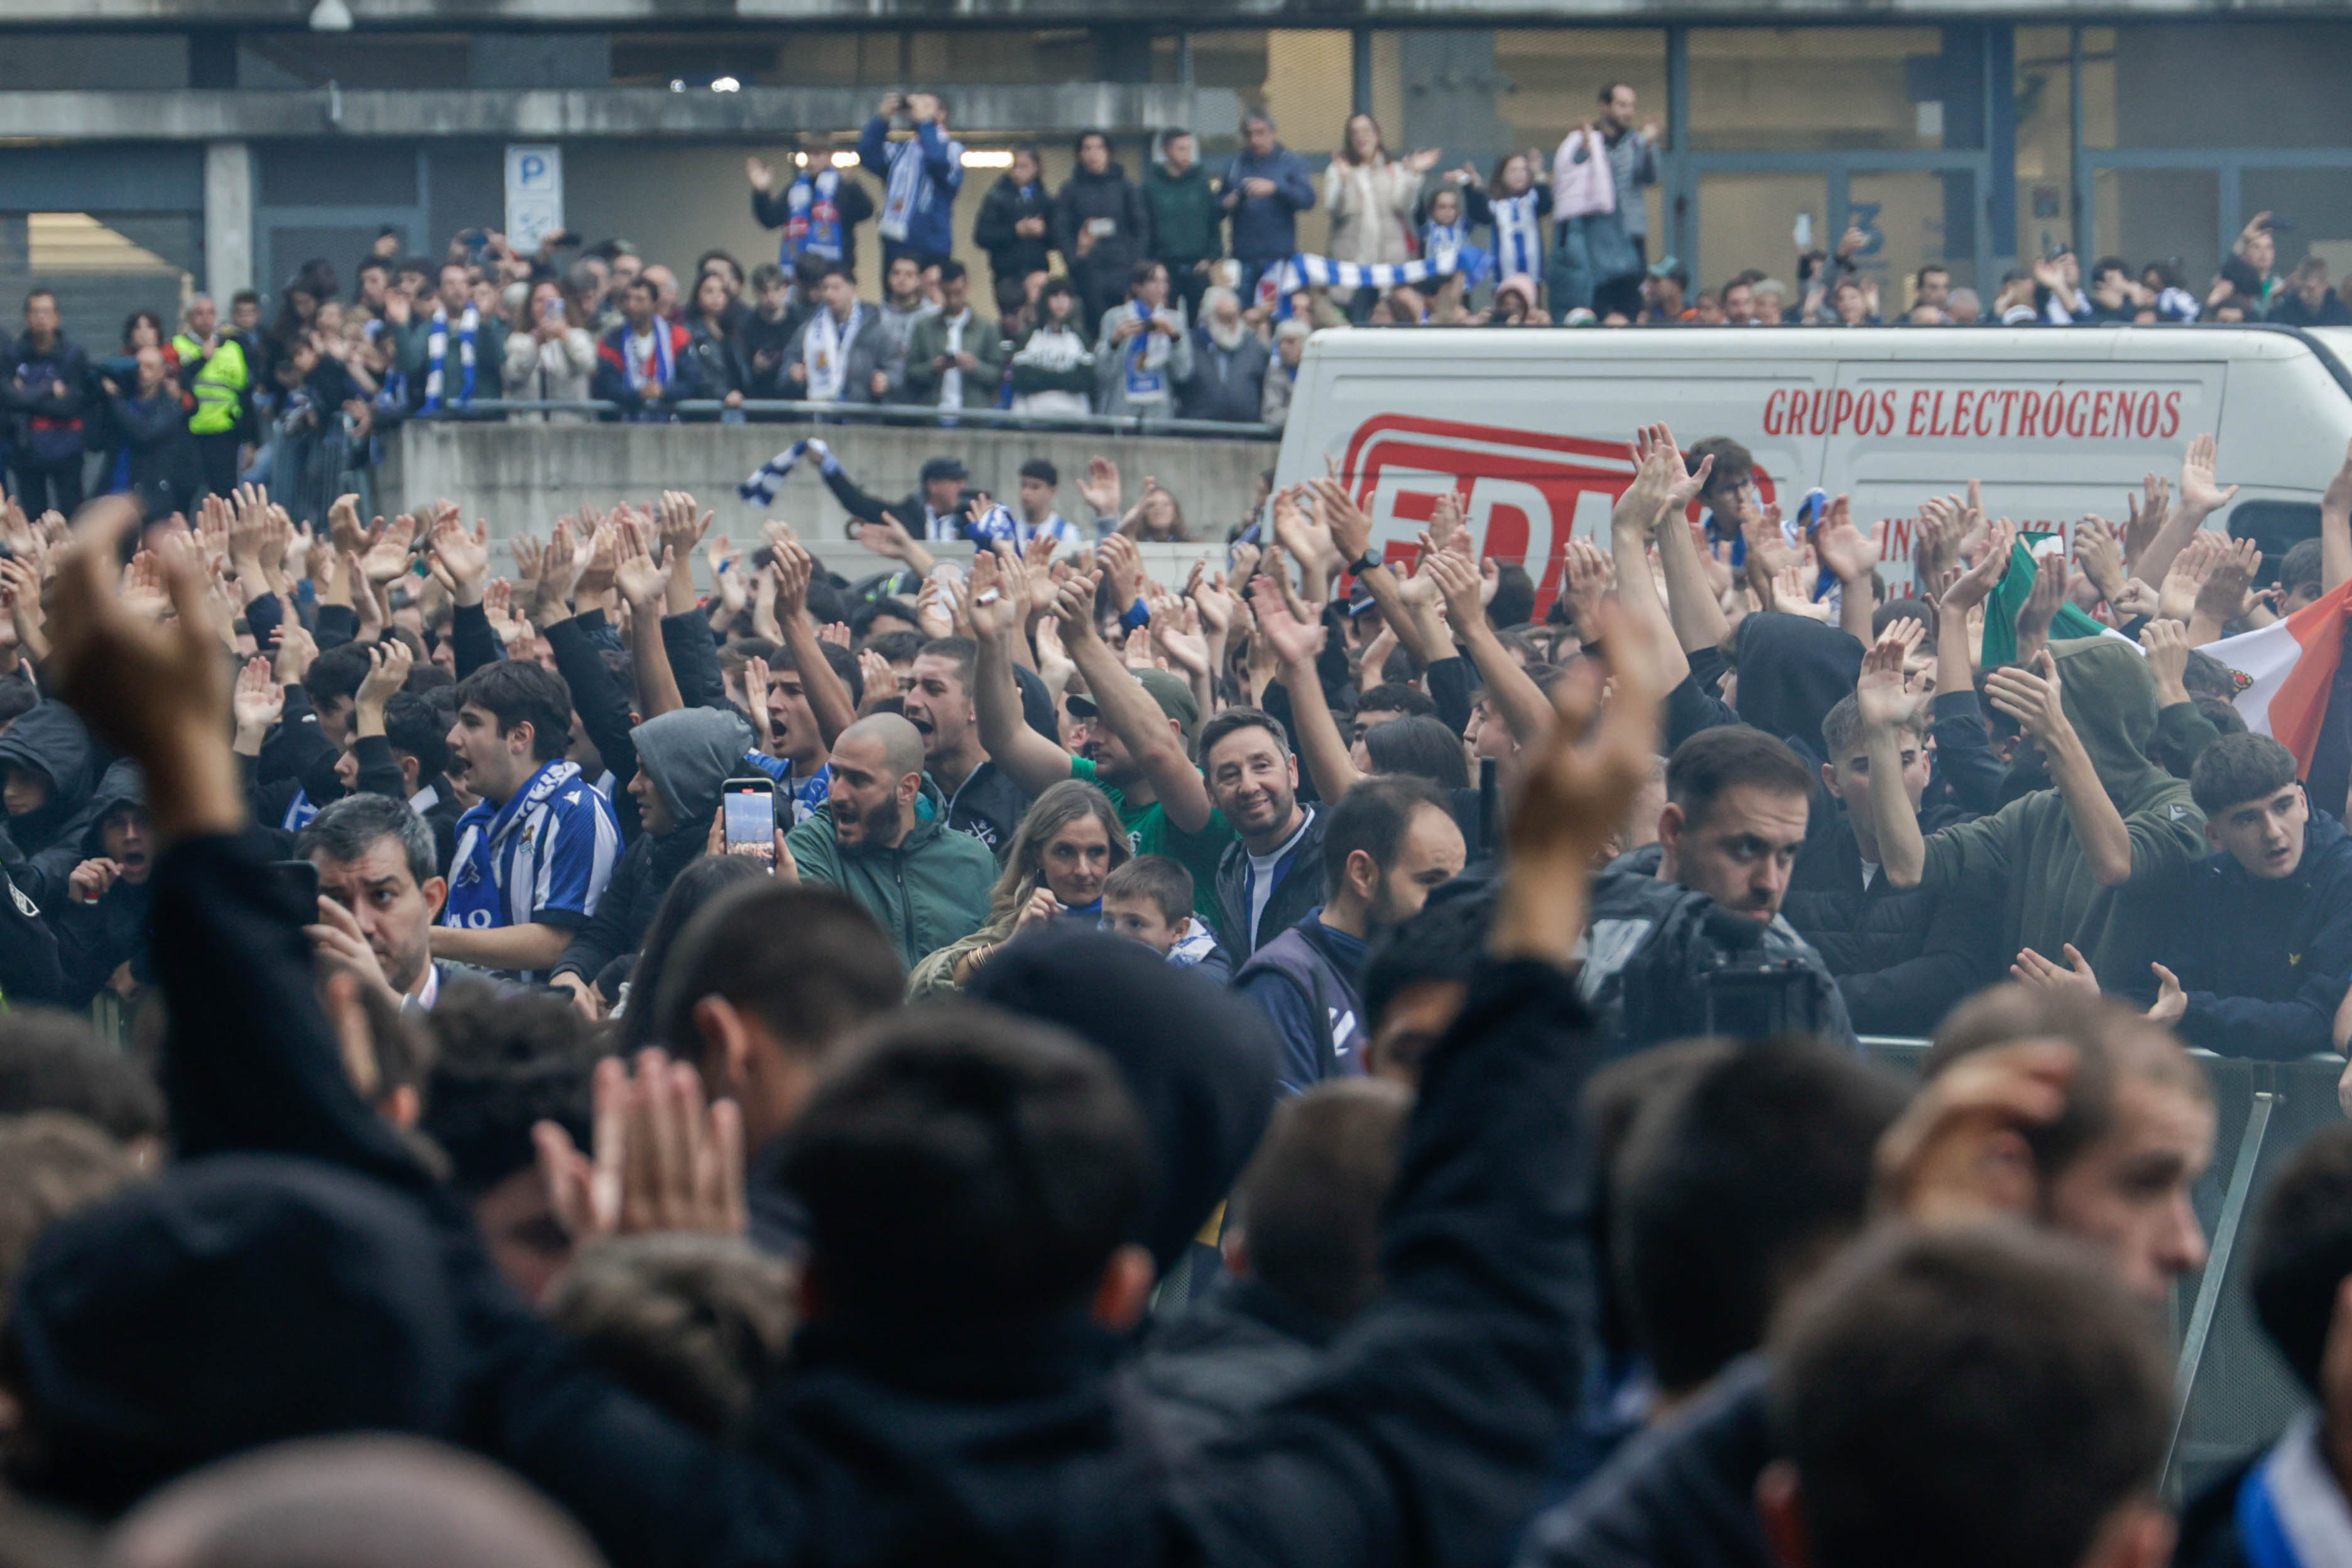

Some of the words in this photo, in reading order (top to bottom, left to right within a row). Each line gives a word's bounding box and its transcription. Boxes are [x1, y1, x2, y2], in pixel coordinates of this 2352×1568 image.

[521, 156, 545, 185] P
[1763, 388, 1897, 437] GRUPOS
[1906, 379, 2182, 439] ELECTRÓGENOS
